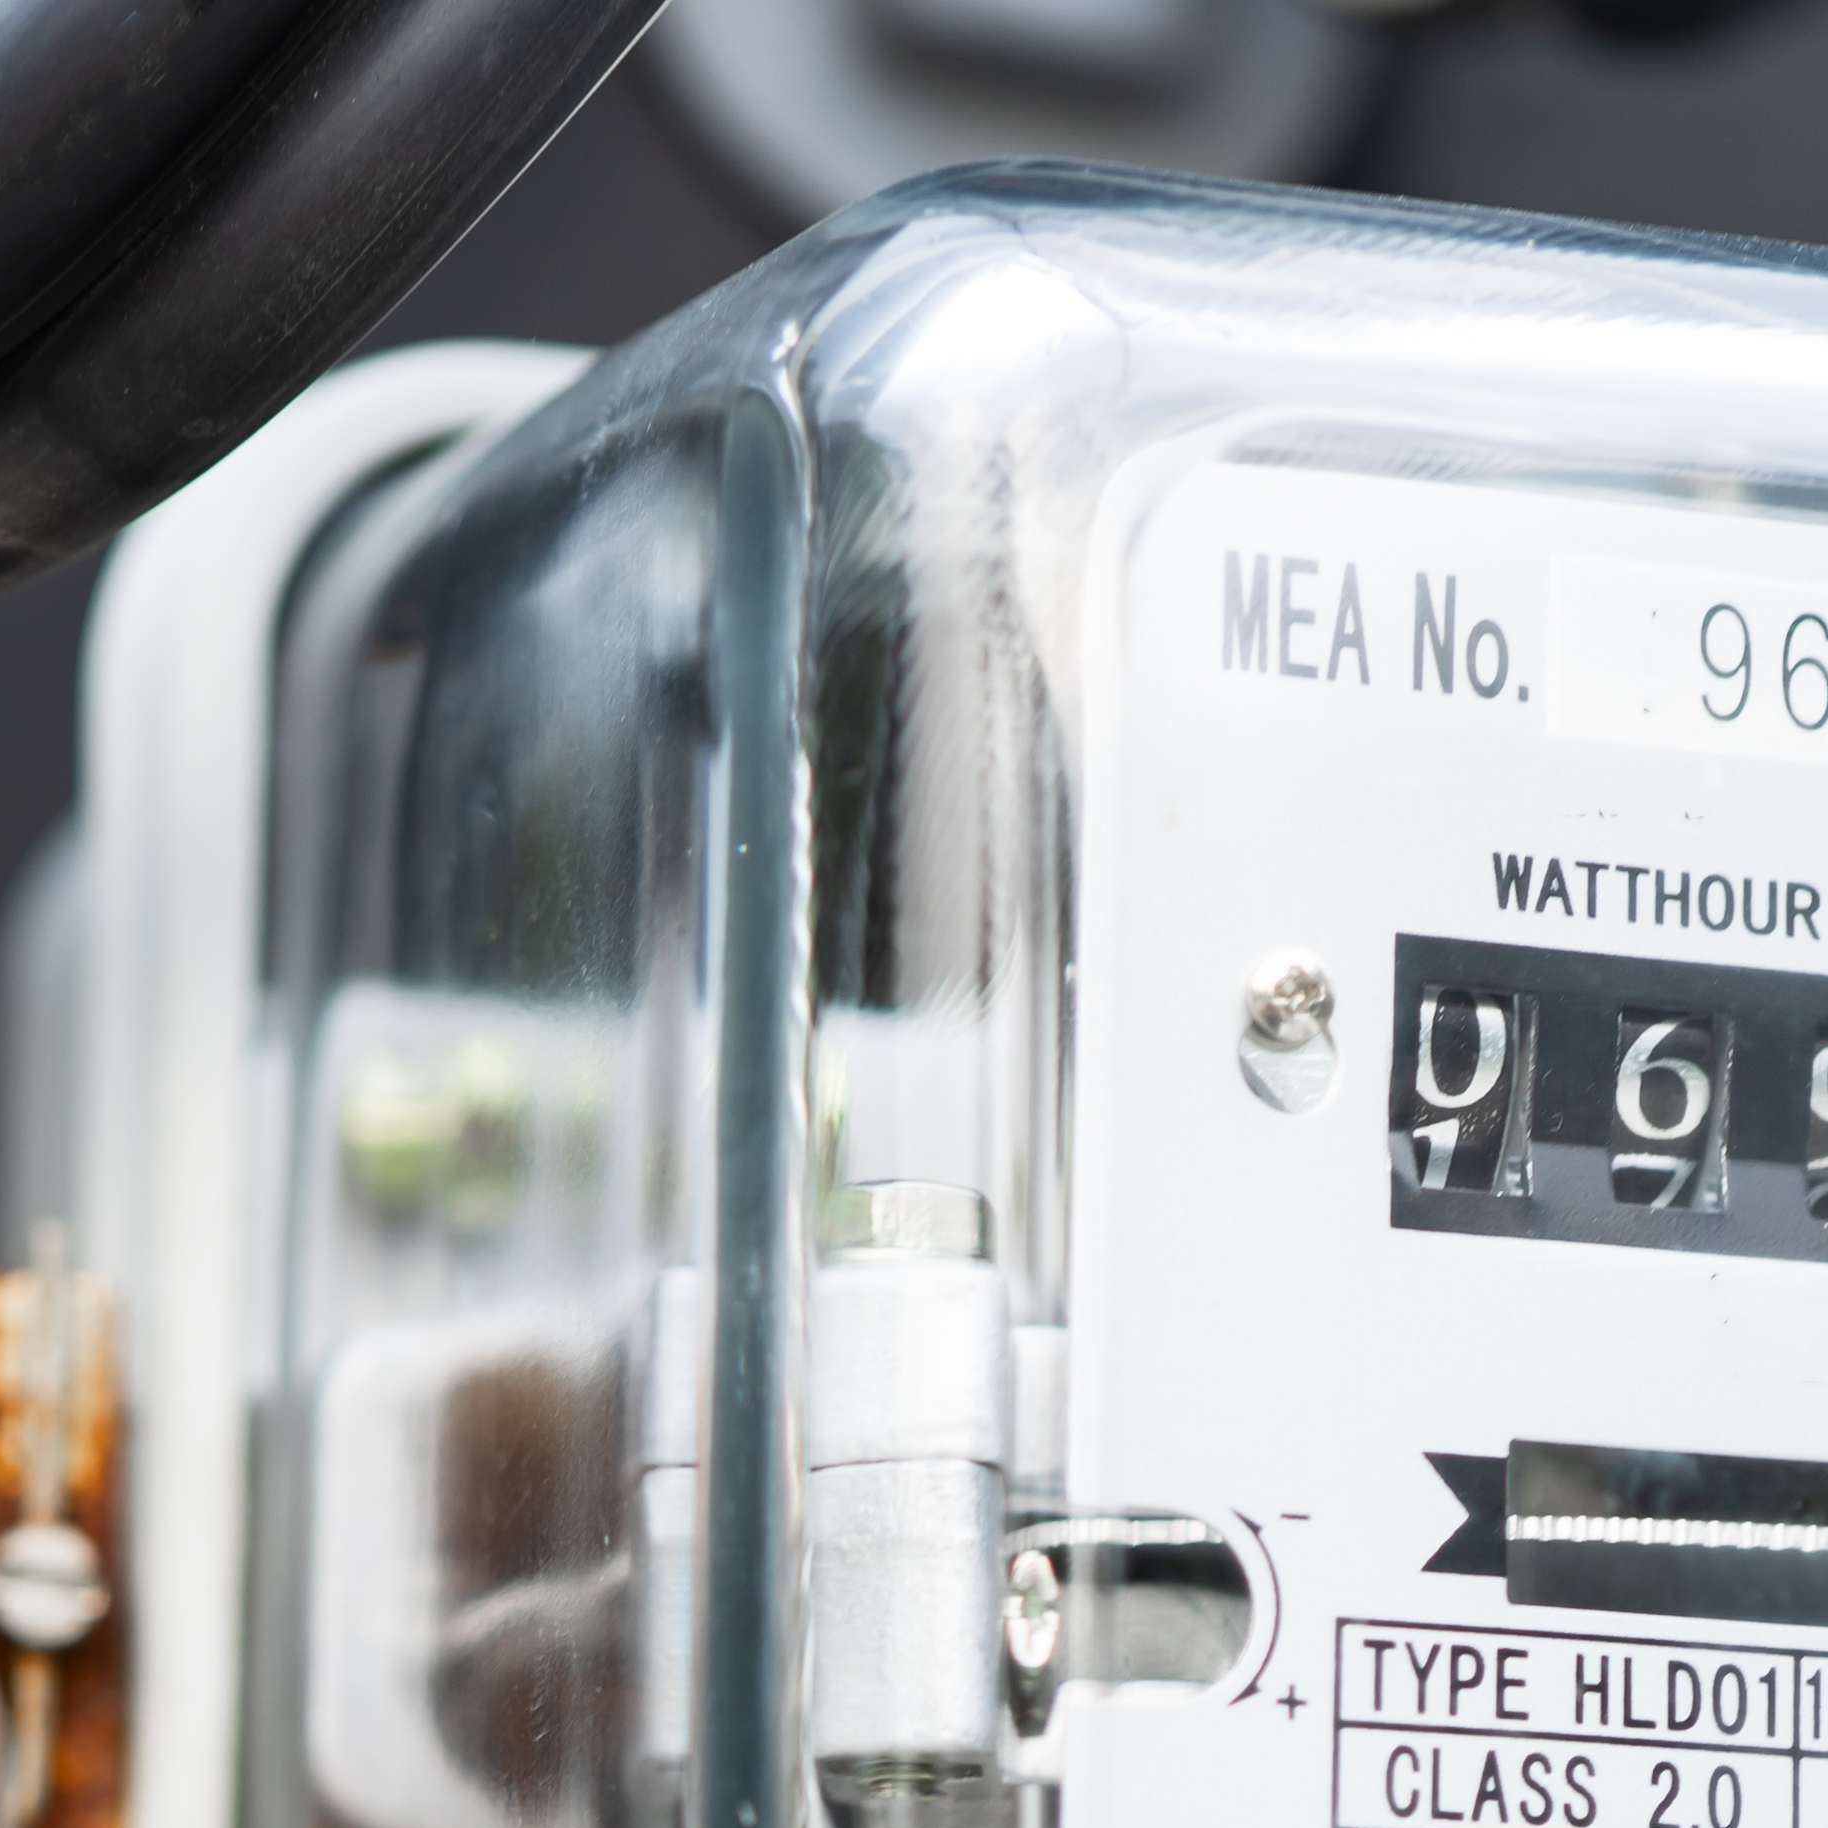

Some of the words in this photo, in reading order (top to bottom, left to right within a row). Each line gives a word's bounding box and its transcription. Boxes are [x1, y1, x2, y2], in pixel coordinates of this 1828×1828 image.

[1222, 549, 1370, 685] MEA
[1413, 571, 1529, 702] No.
[1491, 850, 1822, 940] WATTHOUR
[1362, 1638, 1531, 1721] TYPE
[1806, 1668, 1822, 1740] 1
[1385, 1745, 1598, 1828] CLASS
